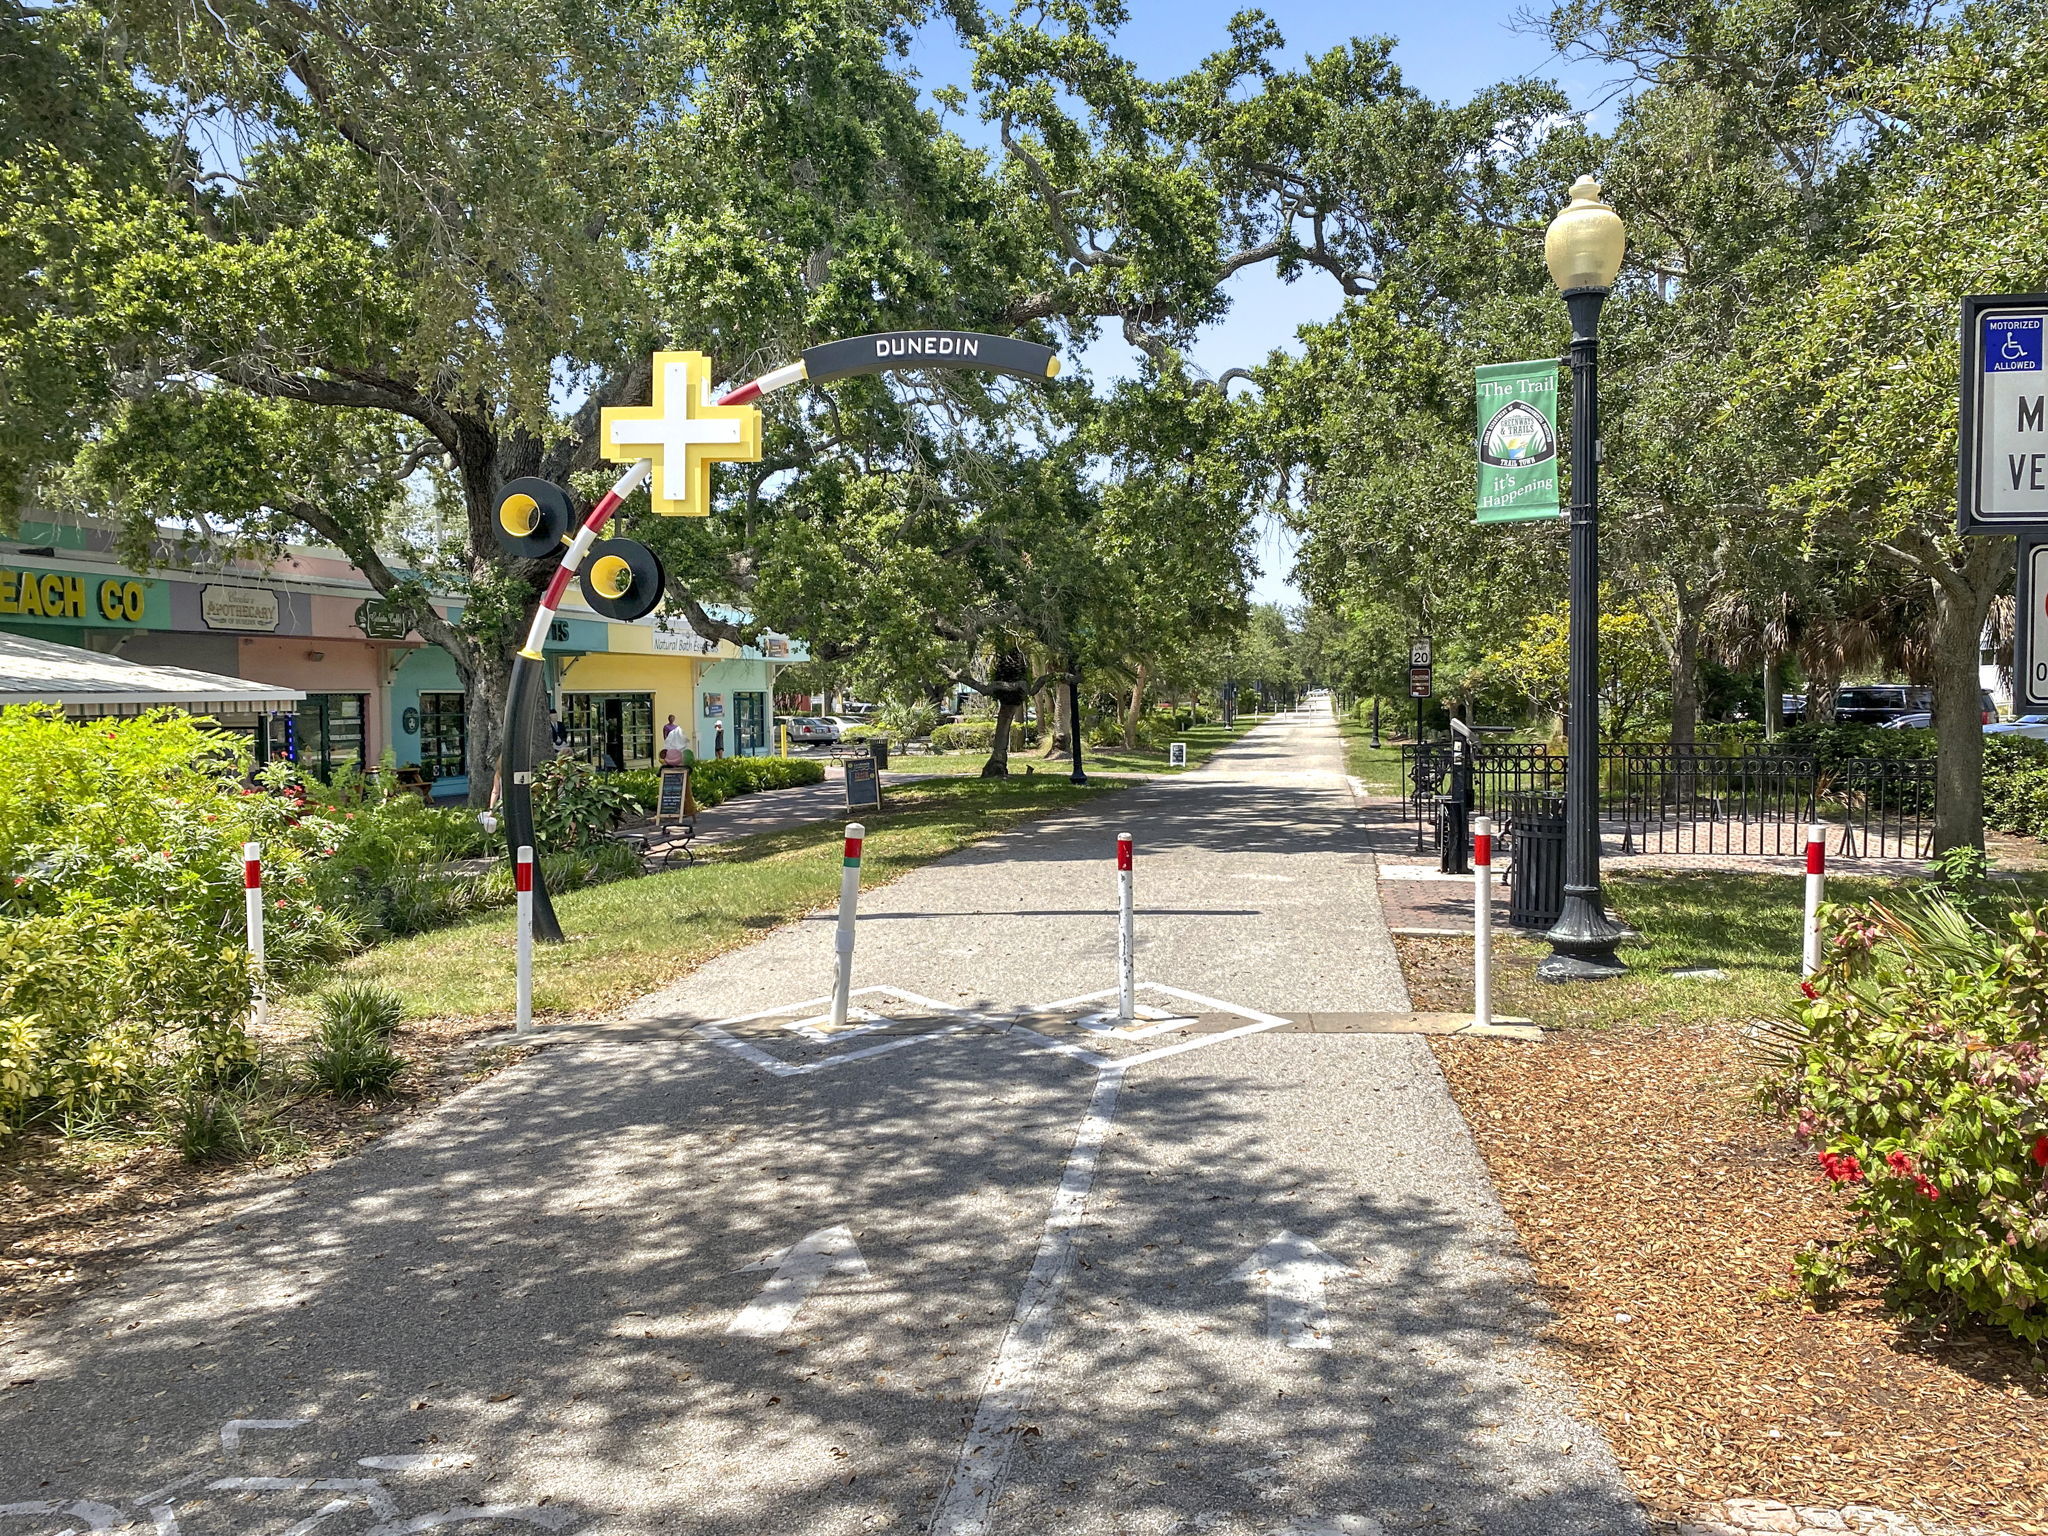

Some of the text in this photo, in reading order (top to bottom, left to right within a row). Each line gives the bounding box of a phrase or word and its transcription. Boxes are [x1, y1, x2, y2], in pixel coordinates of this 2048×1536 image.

[1990, 320, 2040, 330] MOTORIZED
[876, 337, 979, 357] DUNEDIN
[1994, 360, 2036, 371] ALLOWED
[1481, 376, 1555, 397] The Trail
[1500, 417, 1535, 427] GREENWAYS
[1508, 424, 1535, 435] TRAILS
[1500, 456, 1536, 467] TRAIL TOWN
[2008, 453, 2046, 490] VE
[1494, 473, 1516, 492] it's
[1483, 478, 1553, 507] Happening
[100, 579, 145, 622] CO
[206, 599, 276, 619] APOTHECARY
[655, 638, 678, 651] Natural
[679, 640, 693, 652] Bath
[1413, 652, 1428, 663] 20
